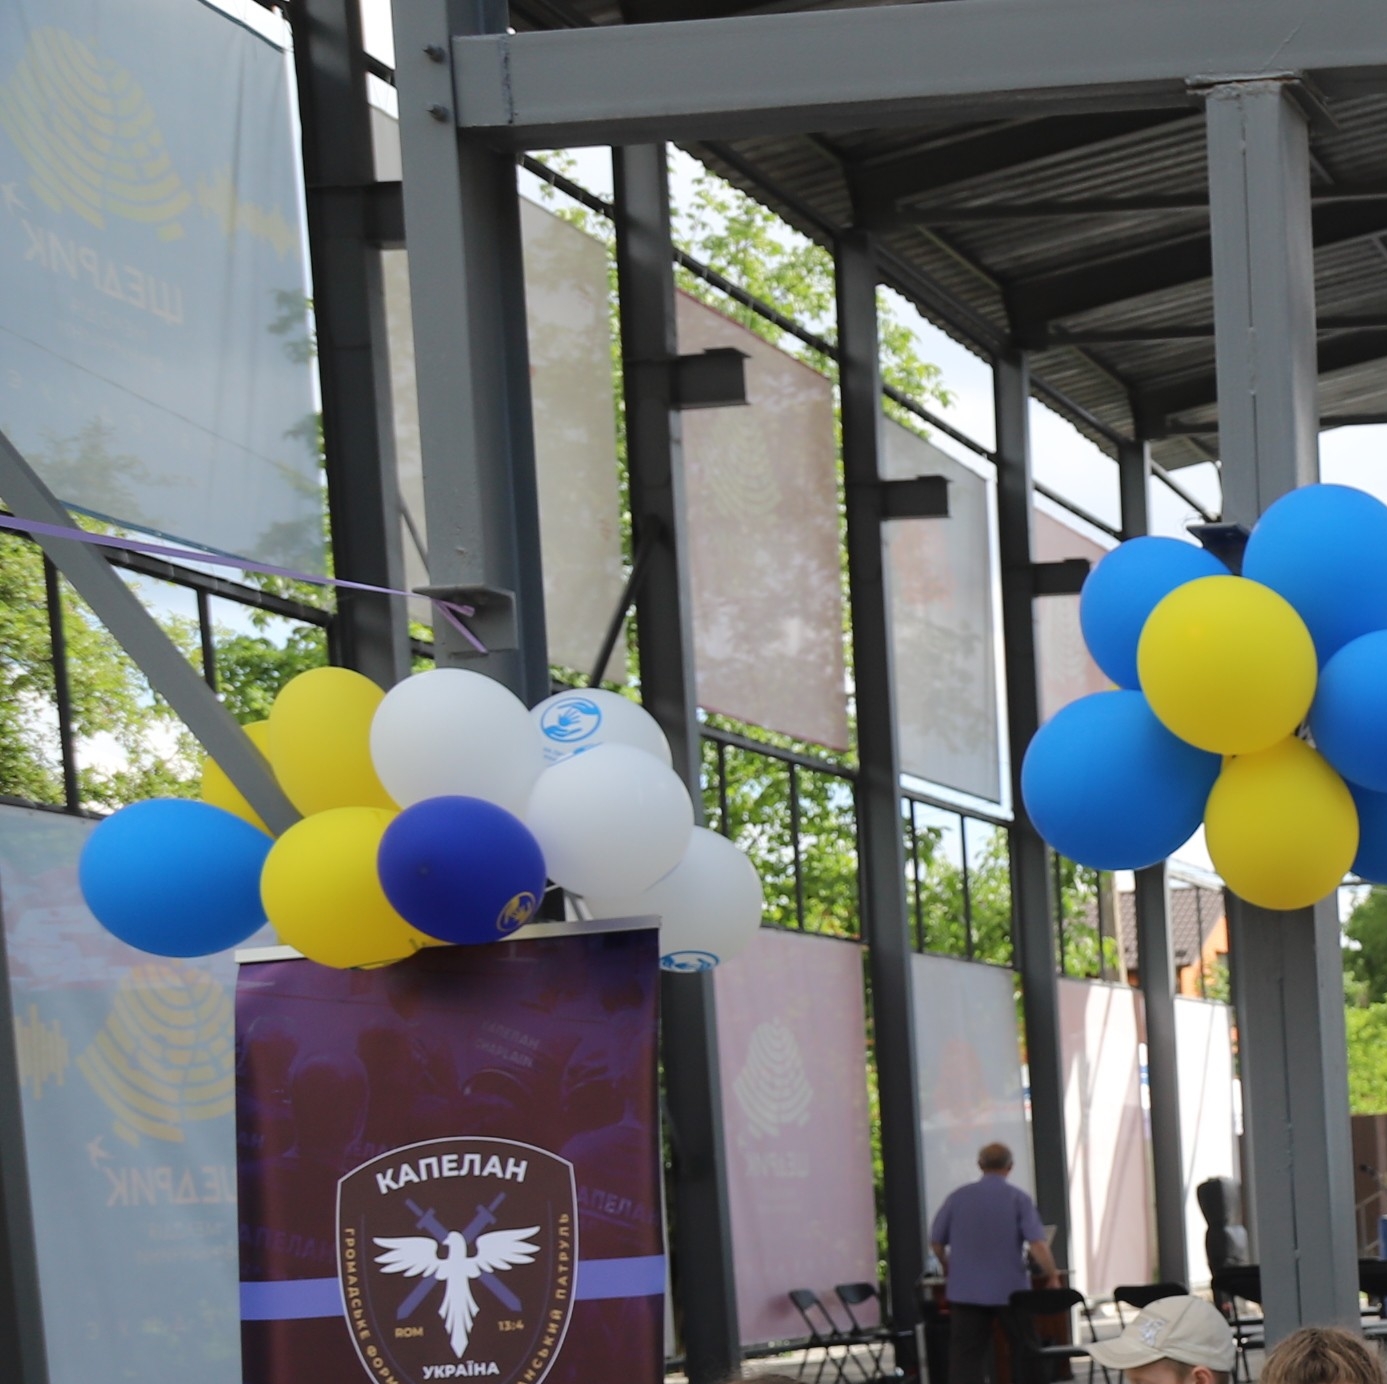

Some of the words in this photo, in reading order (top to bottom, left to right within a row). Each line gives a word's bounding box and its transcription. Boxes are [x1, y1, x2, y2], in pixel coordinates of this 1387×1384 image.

[375, 1153, 528, 1195] КАПЕЛАН
[344, 1227, 371, 1341] ГРОМАДСЬКЕ
[555, 1212, 570, 1300] ПАТРУЛЬ
[394, 1326, 424, 1339] ROM
[497, 1319, 525, 1333] 13:4
[422, 1360, 500, 1381] УКРАЇНА
